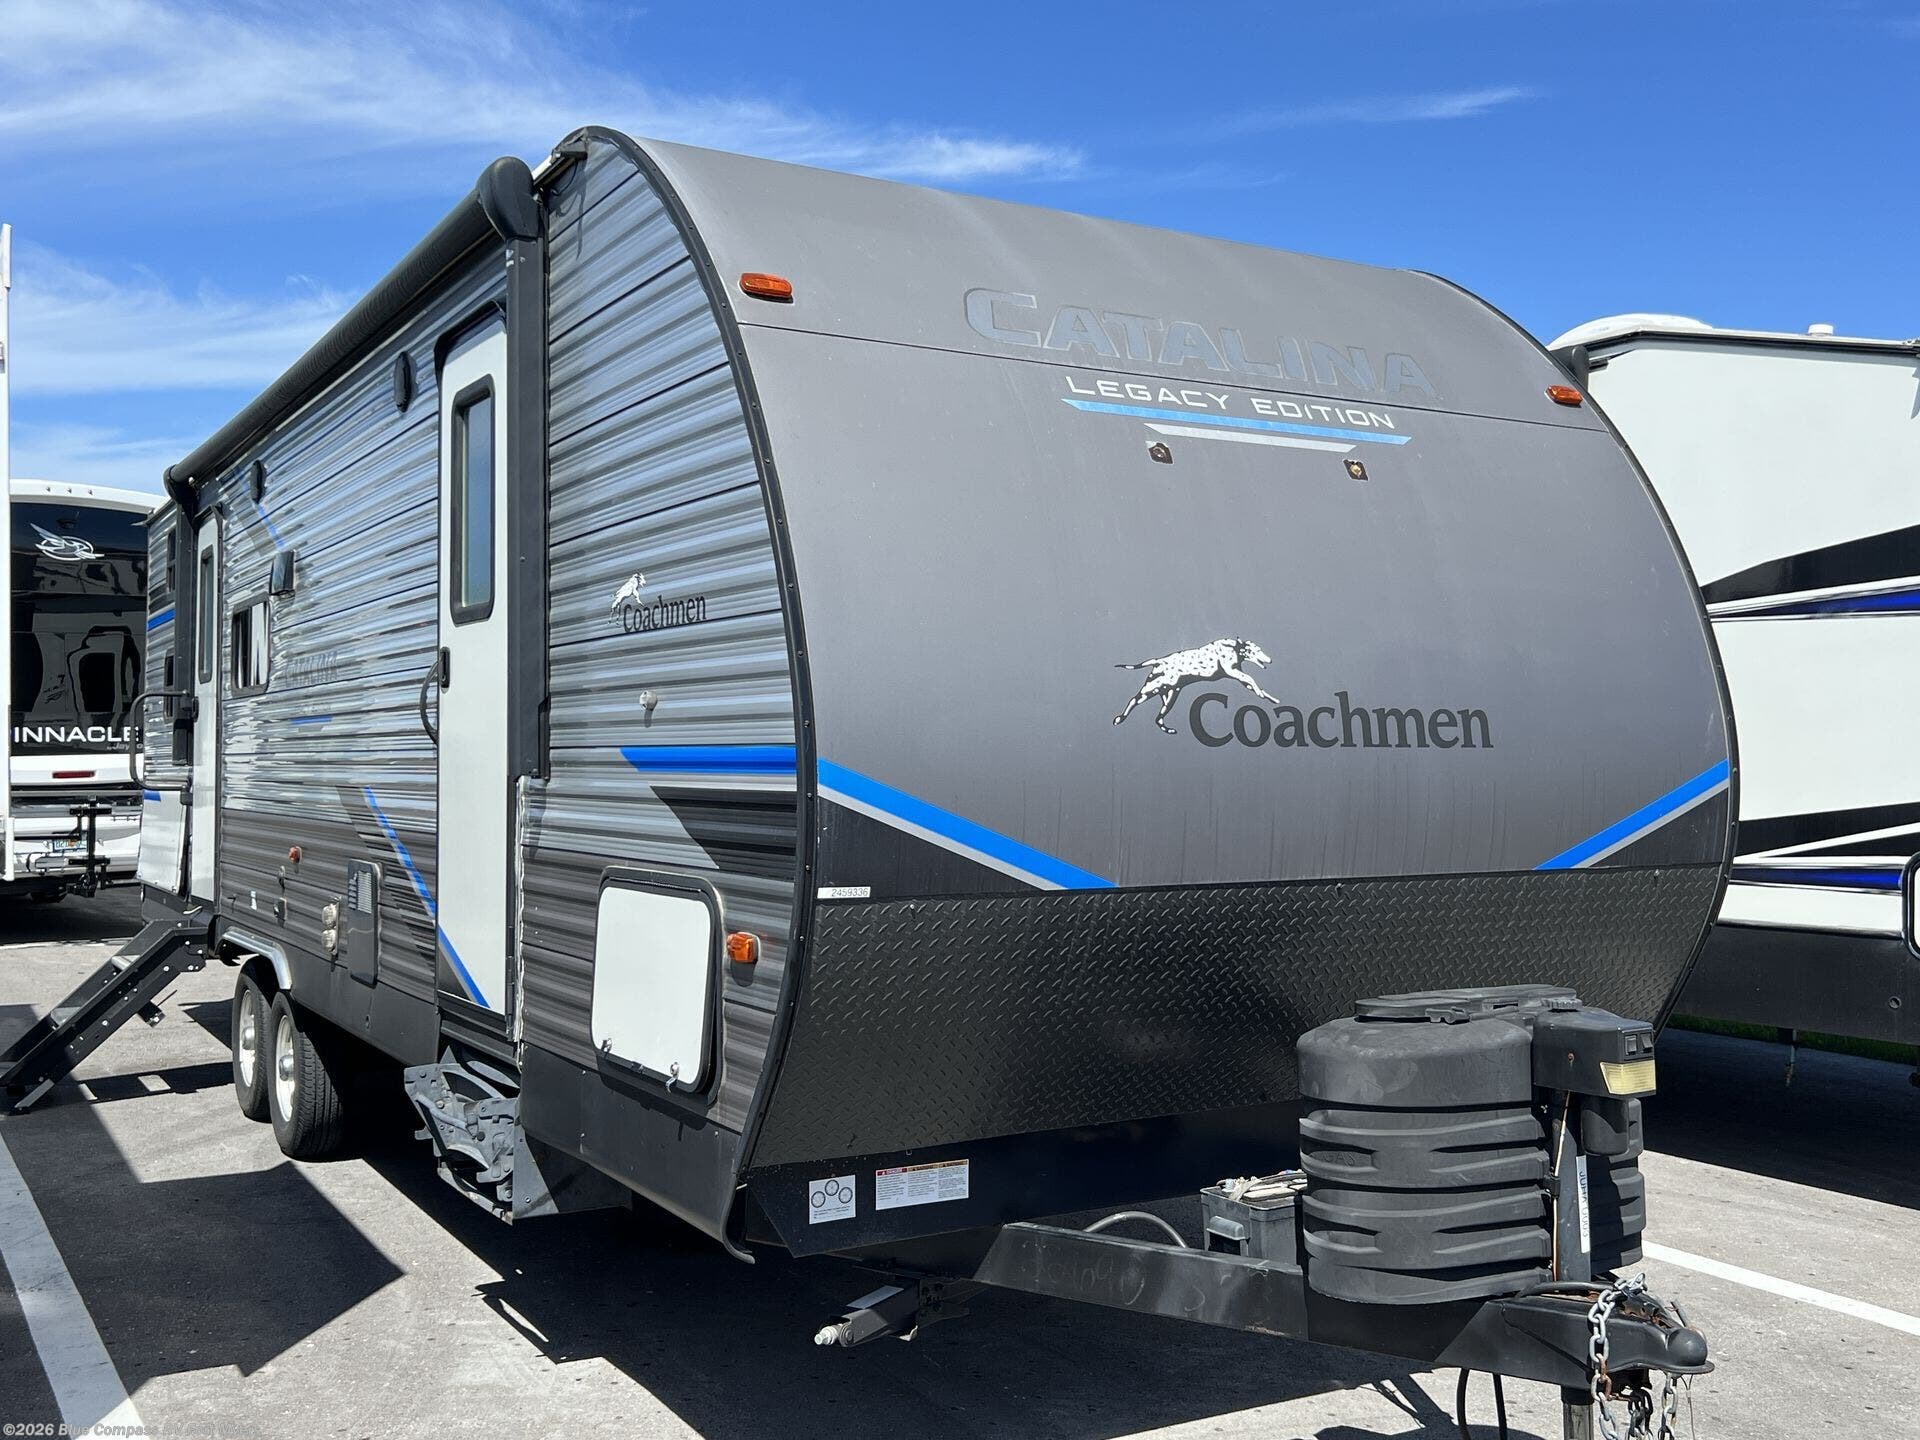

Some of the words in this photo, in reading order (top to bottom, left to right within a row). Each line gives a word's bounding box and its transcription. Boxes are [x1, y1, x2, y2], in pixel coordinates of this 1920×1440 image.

[963, 287, 1437, 394] CATALINA
[1065, 376, 1230, 411] LEGACY
[1254, 398, 1396, 429] EDITION
[623, 595, 707, 633] Coachmen
[11, 726, 139, 742] INNACLE
[1188, 690, 1494, 749] Coachmen
[115, 742, 144, 751] Jayo
[831, 887, 869, 897] 2459336
